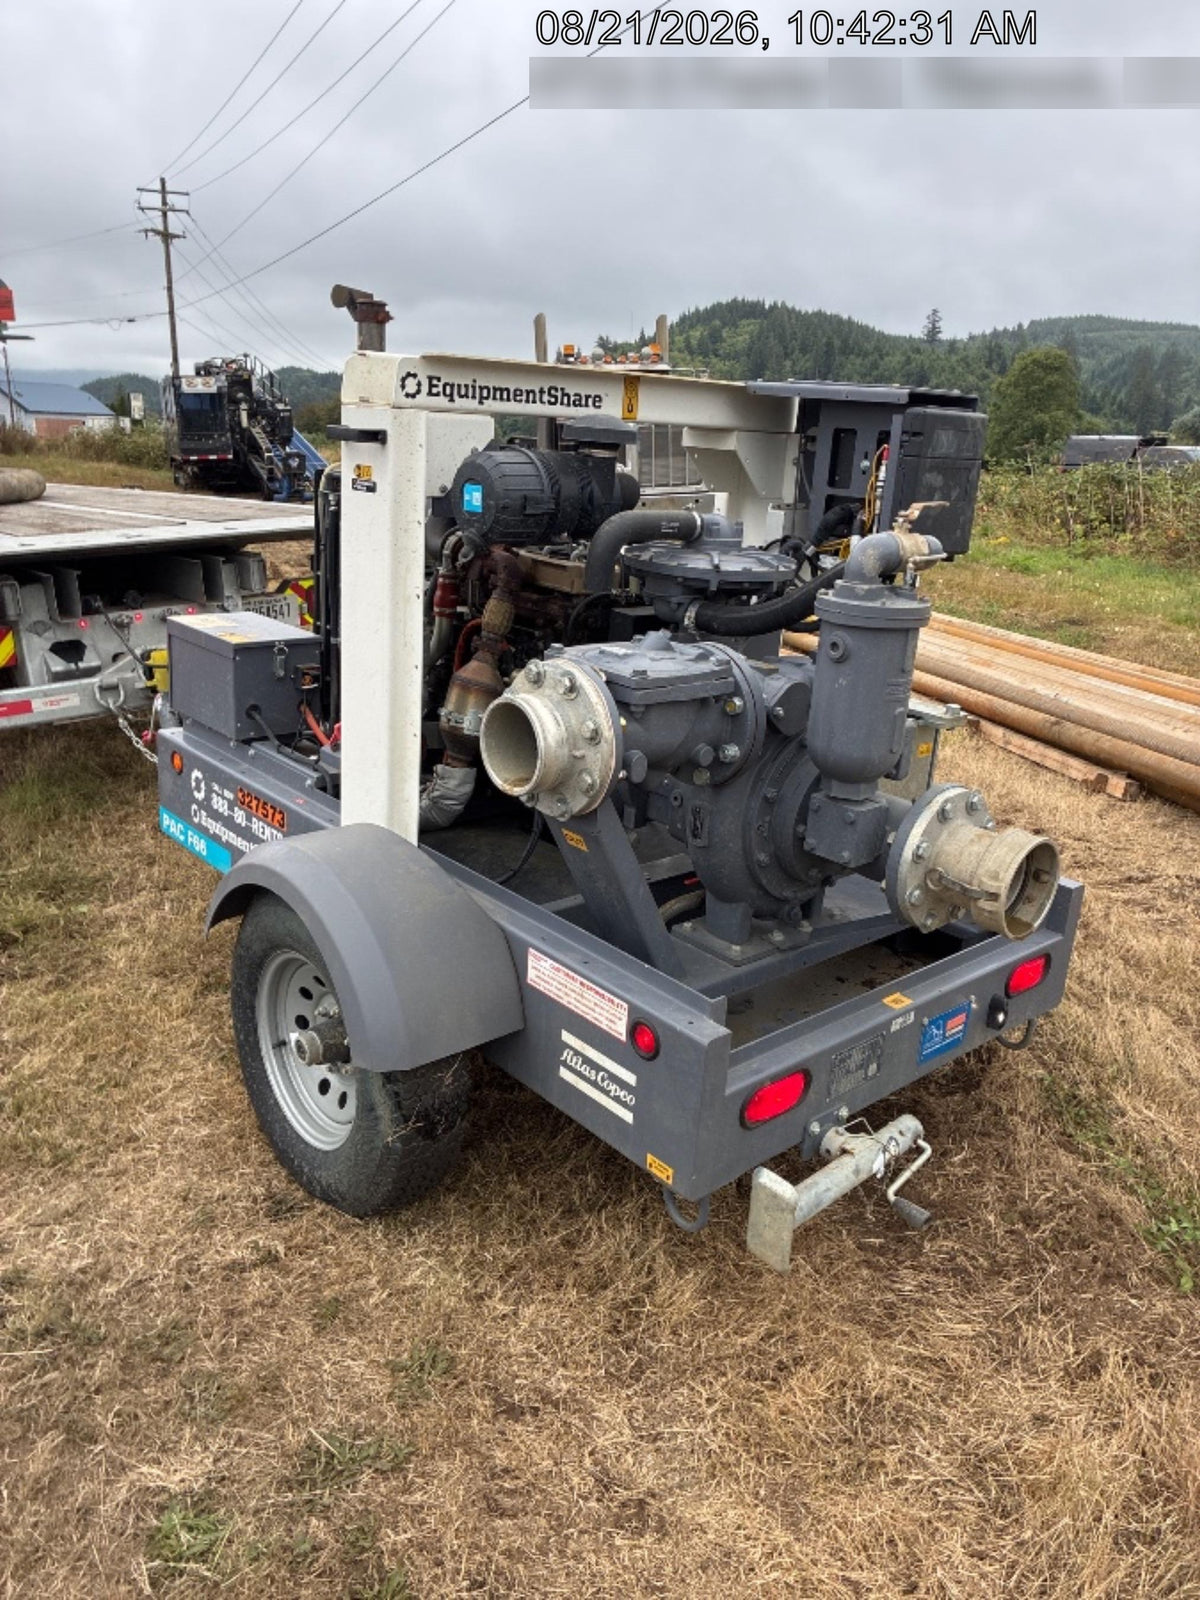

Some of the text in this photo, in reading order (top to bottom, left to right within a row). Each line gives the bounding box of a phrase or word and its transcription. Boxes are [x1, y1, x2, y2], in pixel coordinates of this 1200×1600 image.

[426, 375, 603, 409] EquipmentShare
[239, 787, 286, 829] 327573
[163, 813, 185, 842] PAC
[560, 1048, 636, 1106] Atlas Copco
